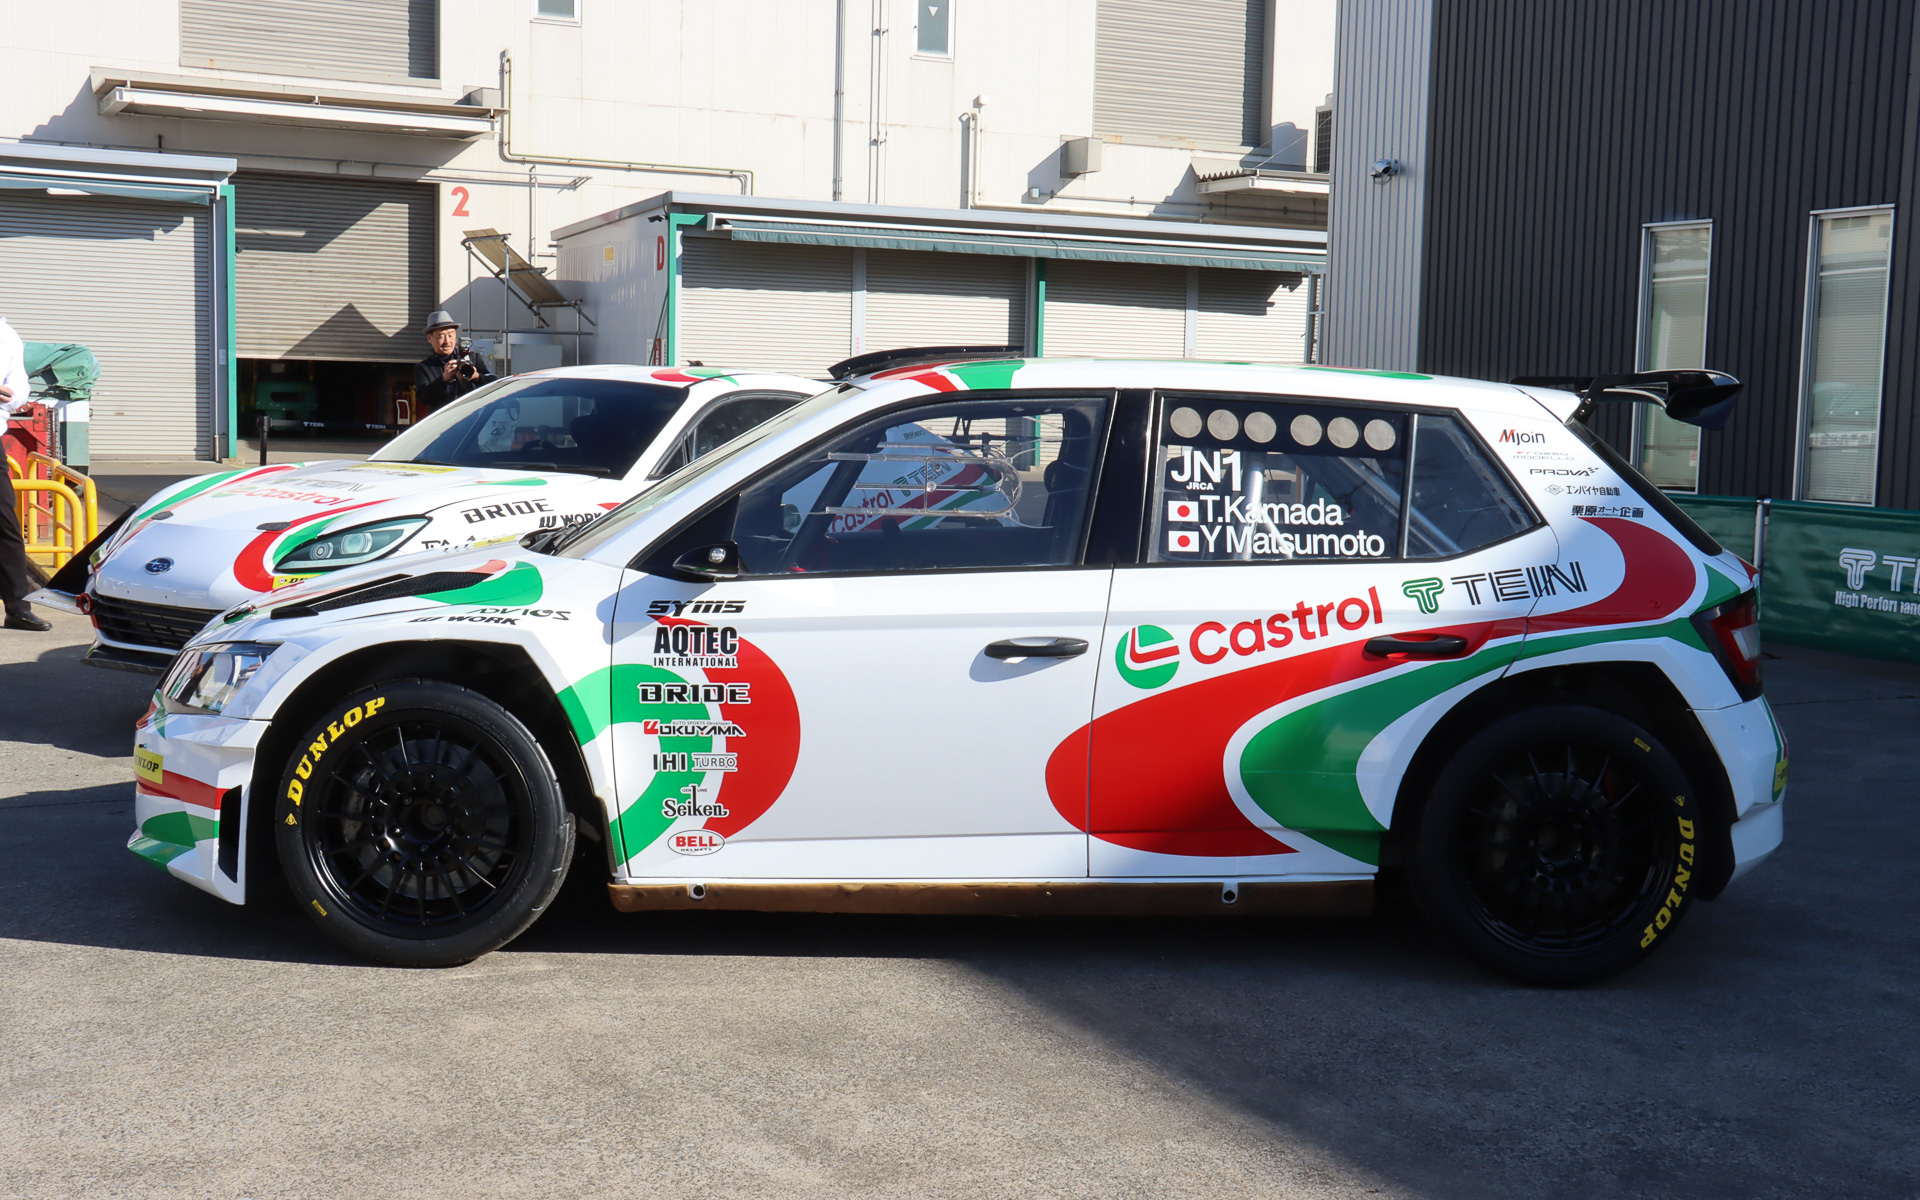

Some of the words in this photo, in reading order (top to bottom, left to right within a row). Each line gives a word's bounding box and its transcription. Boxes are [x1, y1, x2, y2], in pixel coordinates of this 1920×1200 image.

[451, 186, 470, 217] 2
[656, 235, 665, 271] D
[1170, 450, 1242, 491] JN1
[1186, 481, 1215, 491] JRCA
[1529, 468, 1591, 477] PROVA
[460, 499, 555, 524] BRIDE
[560, 512, 603, 526] WORK
[1199, 495, 1344, 526] T.Kamada
[1226, 524, 1386, 556] Matsumoto
[1450, 561, 1588, 606] TEIN
[1834, 590, 1859, 608] High
[447, 616, 522, 626] WORK
[1189, 585, 1384, 665] Castrol
[653, 626, 738, 657] AQTEC
[653, 657, 737, 667] INTERNATIONAL
[639, 684, 750, 703] BRIDE
[286, 696, 386, 807] DUNLOP
[653, 754, 686, 770] IHI
[693, 757, 736, 767] TURBO
[663, 785, 728, 817] Seiken
[675, 836, 718, 847] BELL
[1640, 815, 1695, 949] DUNLOP
